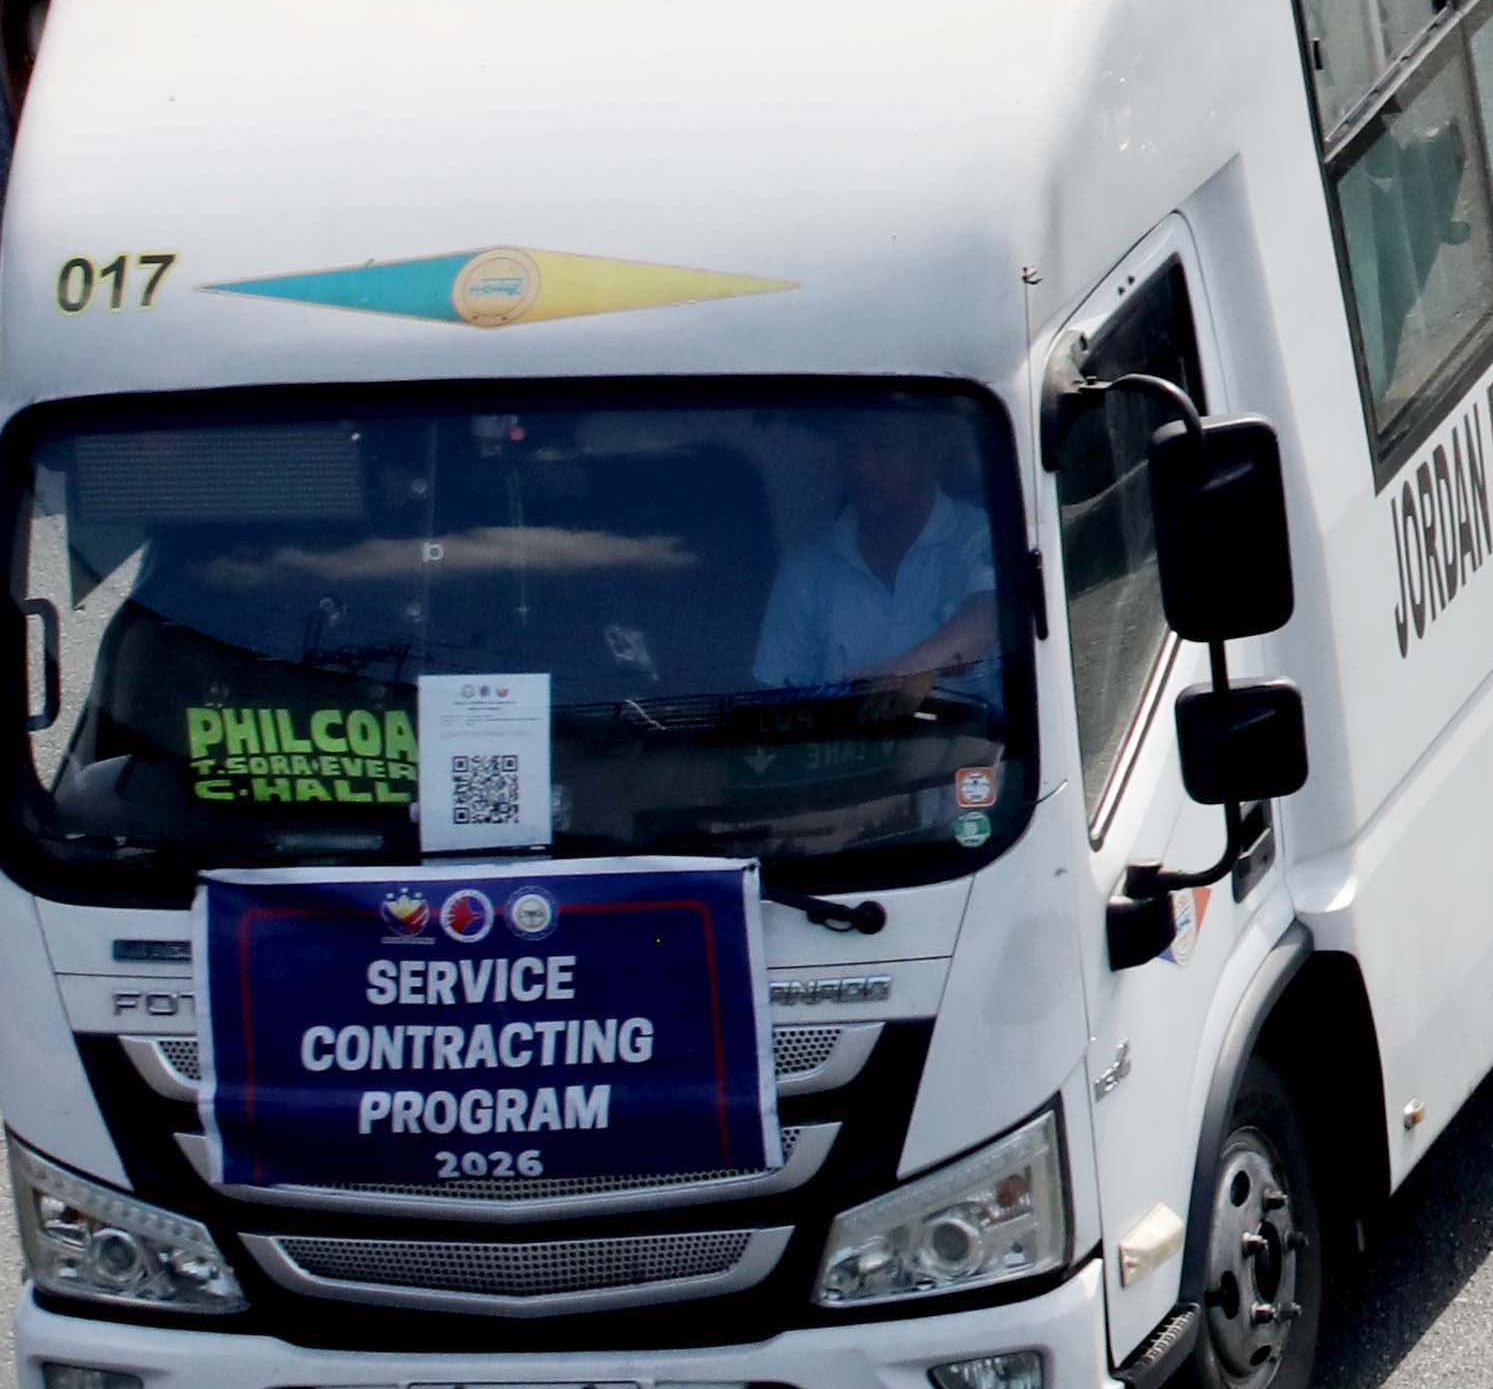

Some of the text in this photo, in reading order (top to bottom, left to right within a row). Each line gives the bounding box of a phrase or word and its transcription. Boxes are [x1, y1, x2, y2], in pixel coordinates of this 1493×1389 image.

[56, 253, 176, 314] 017
[186, 706, 419, 759] PHILCOA
[113, 990, 196, 1017] FOT
[365, 955, 576, 1006] SERVICE
[300, 1017, 654, 1072] CONTRACTING
[357, 1083, 611, 1135] PROGRAM
[434, 1150, 544, 1180] 2026
